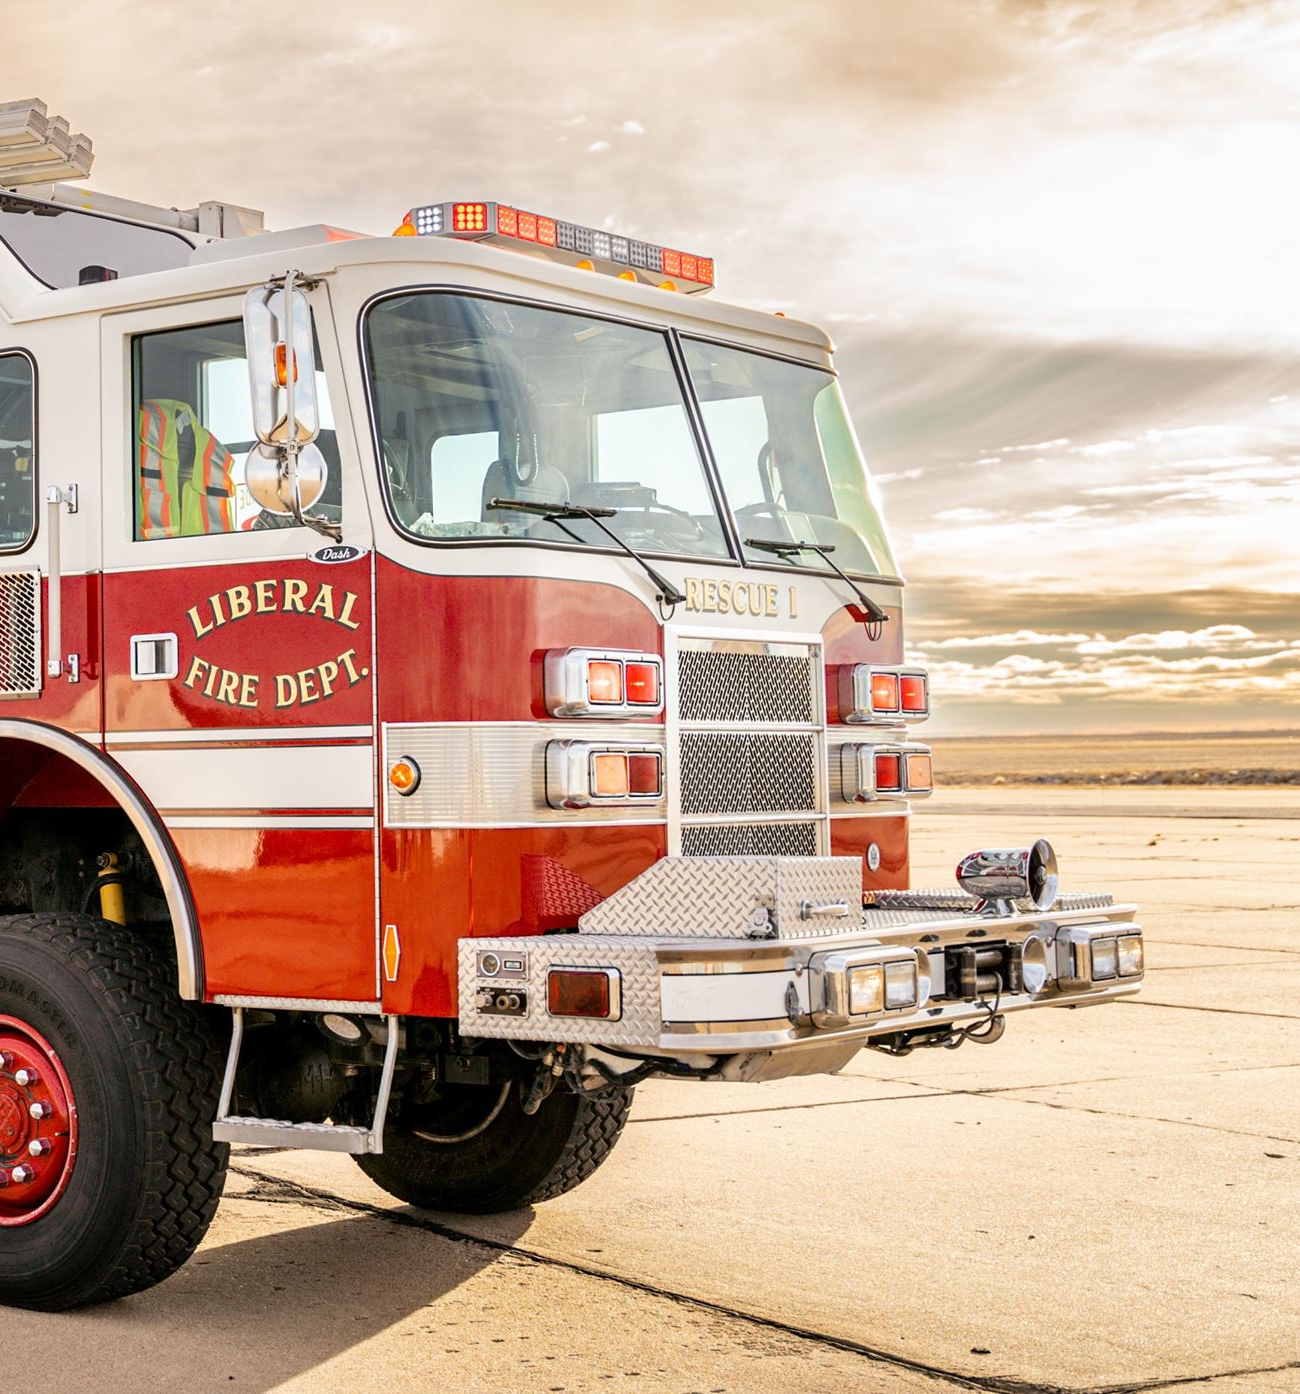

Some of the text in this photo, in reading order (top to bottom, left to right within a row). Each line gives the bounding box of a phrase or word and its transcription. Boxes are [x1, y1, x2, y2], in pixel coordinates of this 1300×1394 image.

[322, 548, 350, 560] Dash
[186, 579, 361, 639] LIBERAL
[685, 578, 798, 618] RESCUE 1
[183, 648, 369, 709] FIRE DEPT.
